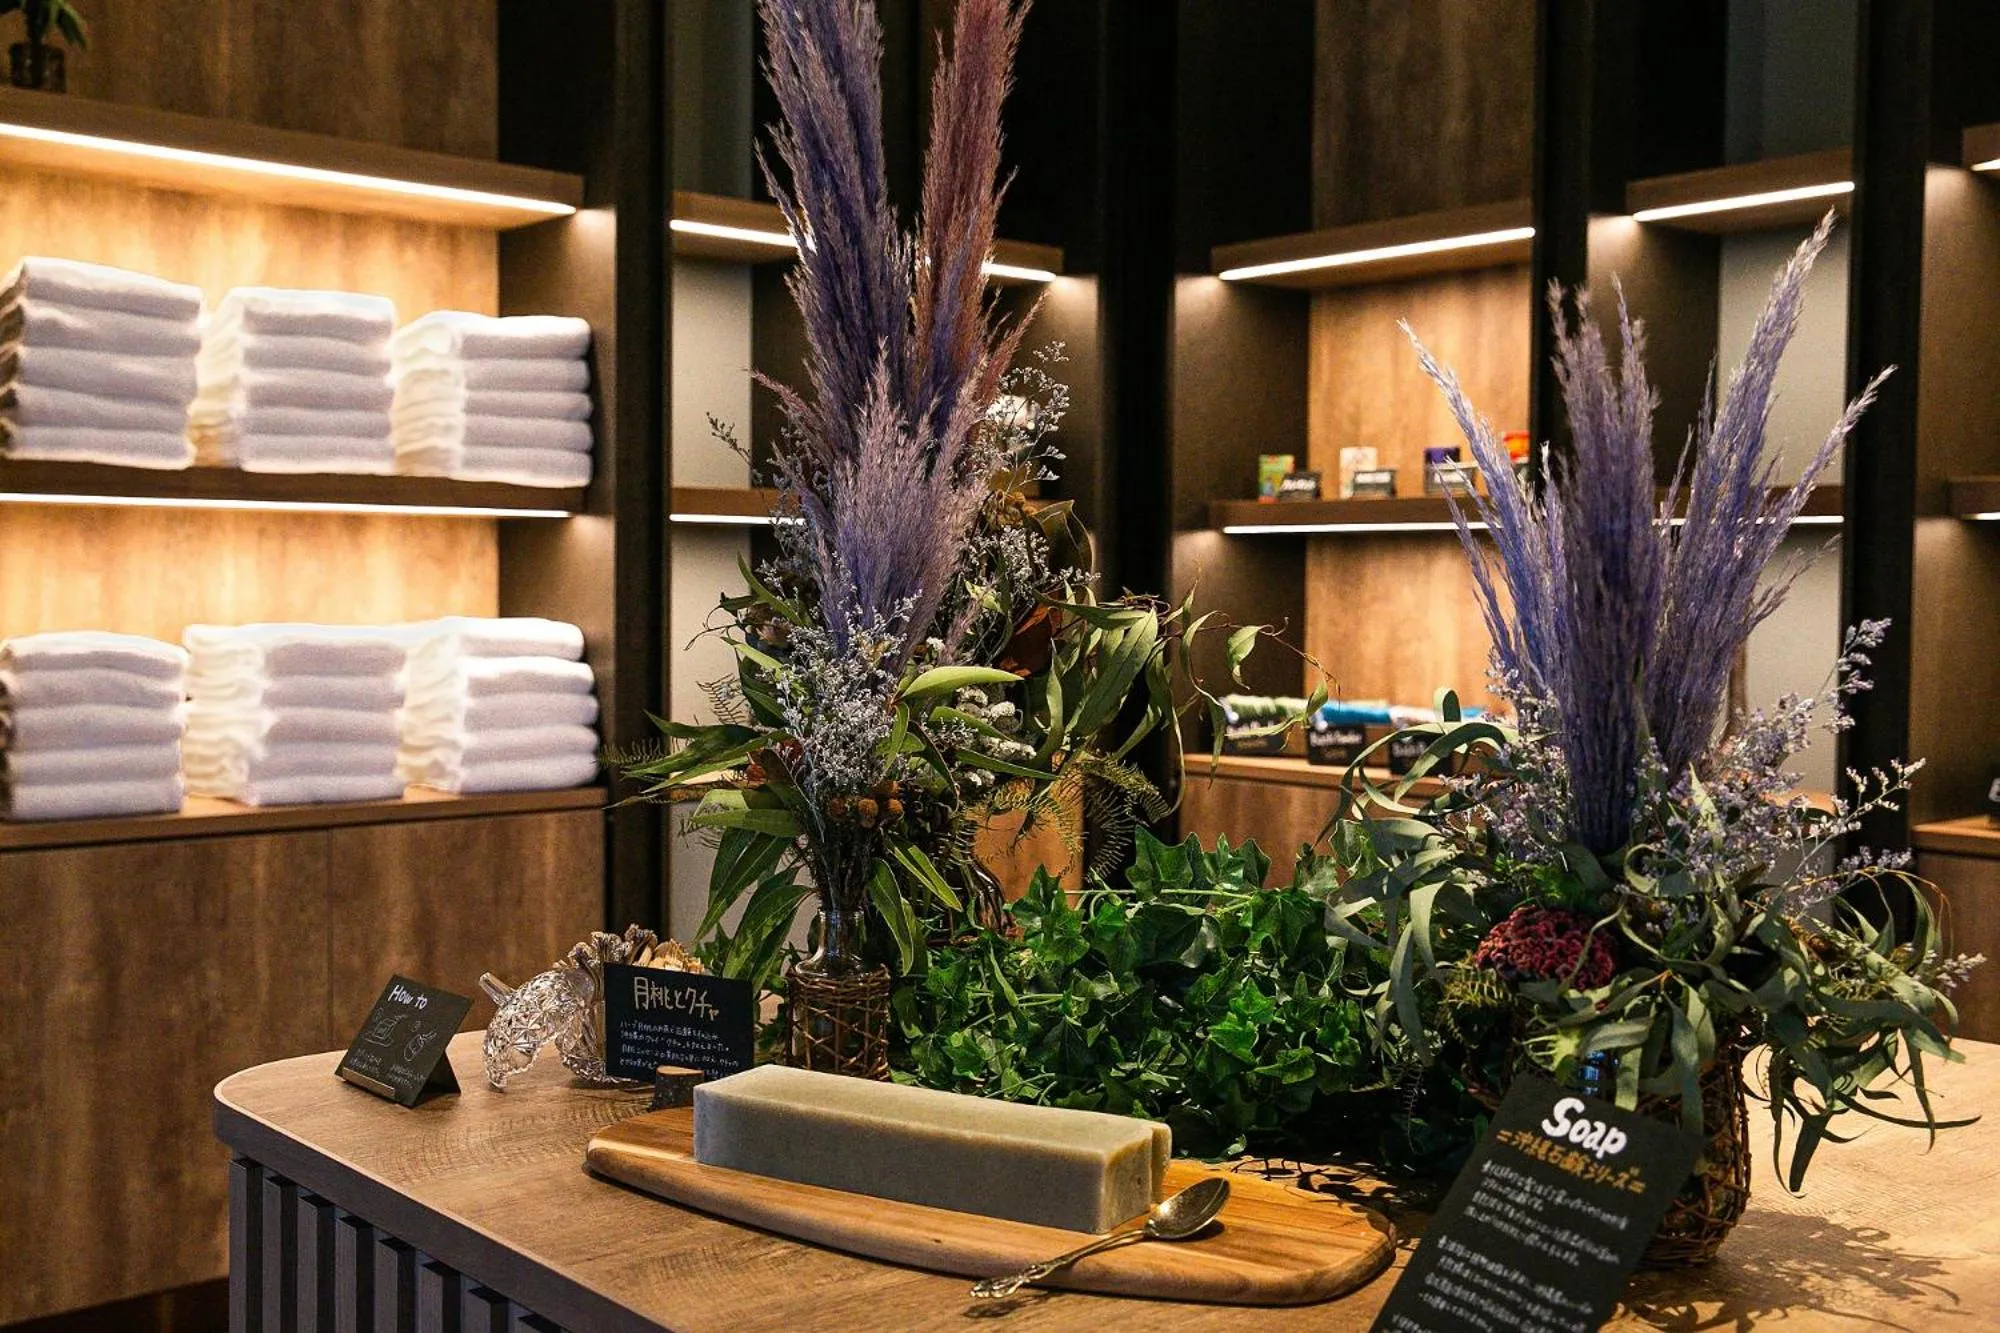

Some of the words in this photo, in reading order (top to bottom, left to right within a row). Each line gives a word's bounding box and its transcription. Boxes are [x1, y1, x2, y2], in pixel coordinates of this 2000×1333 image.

[387, 984, 414, 1005] How
[414, 993, 428, 1010] to
[633, 976, 720, 1021] 月桃とクチャ
[1541, 1097, 1628, 1160] Soap
